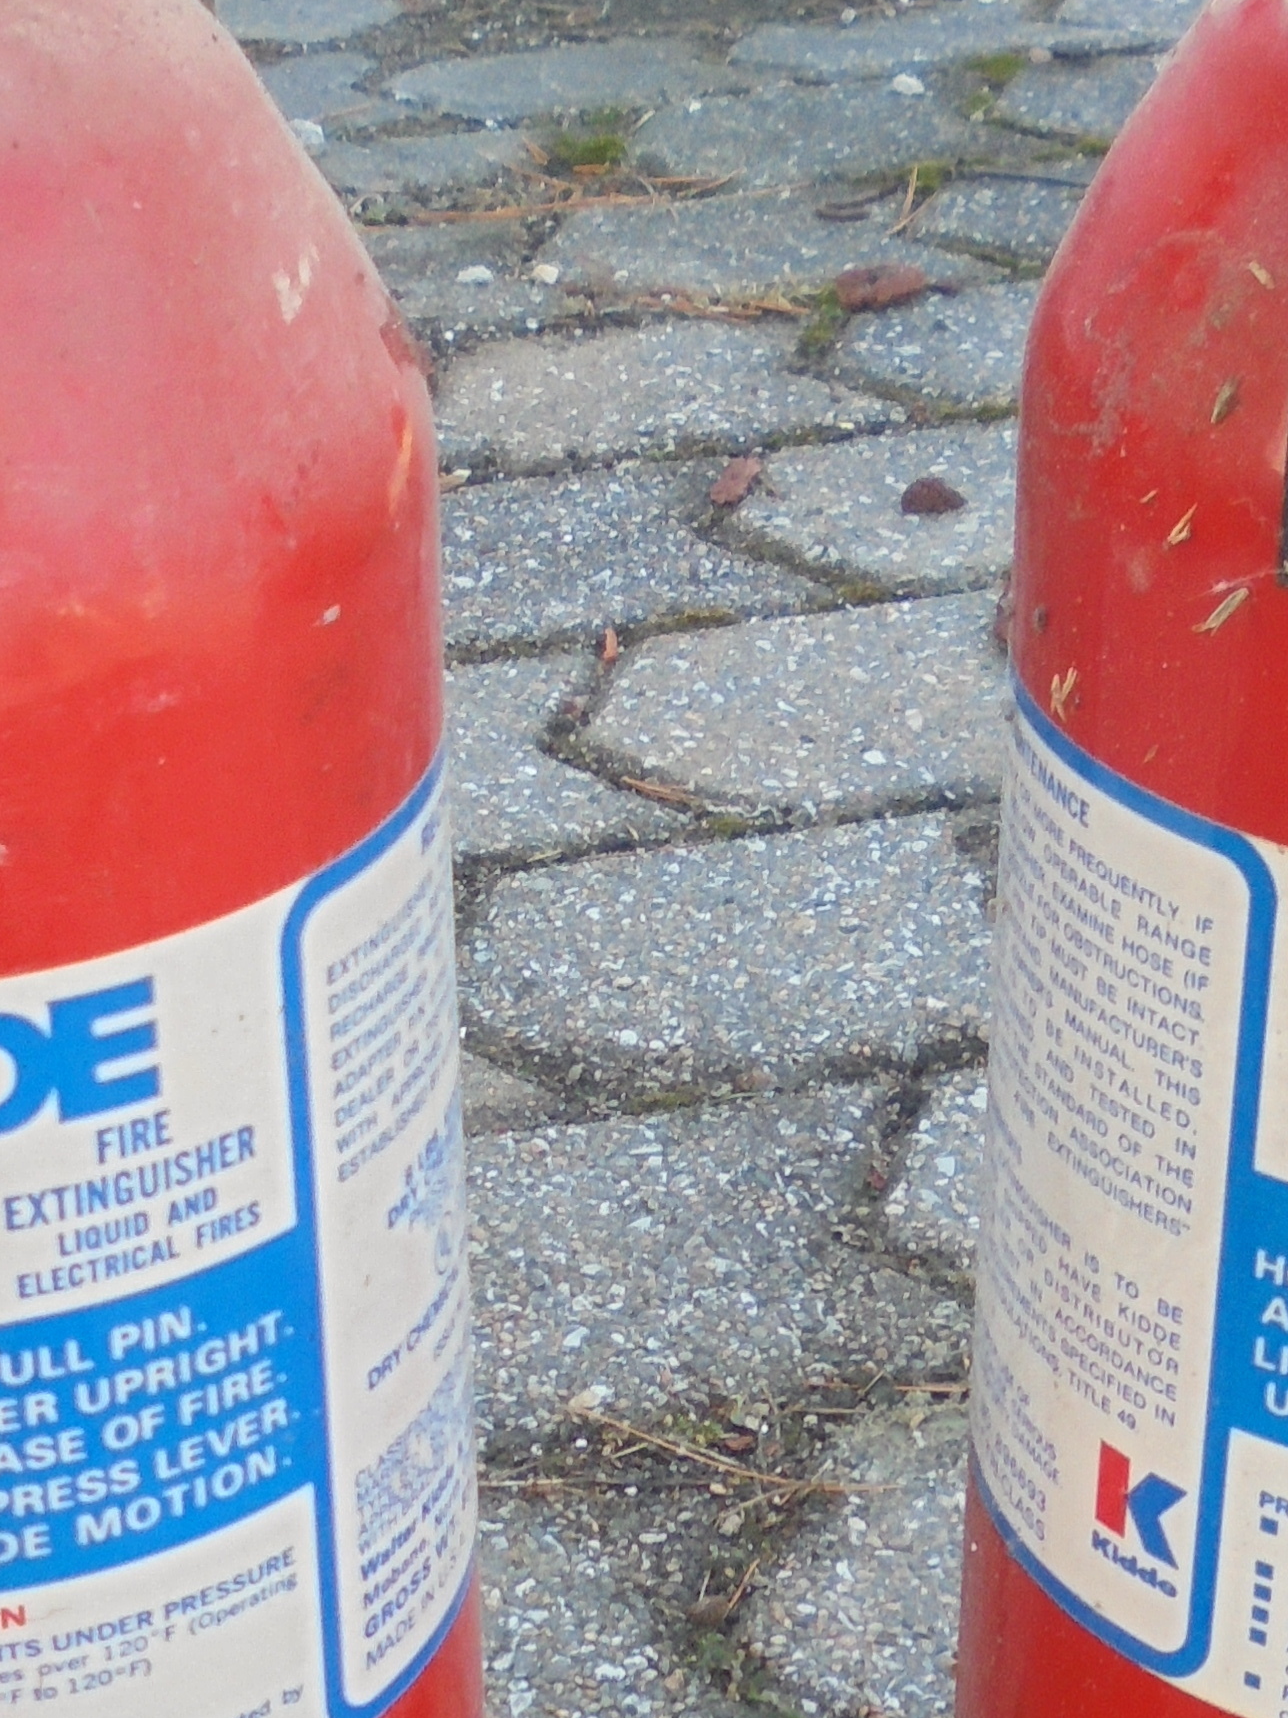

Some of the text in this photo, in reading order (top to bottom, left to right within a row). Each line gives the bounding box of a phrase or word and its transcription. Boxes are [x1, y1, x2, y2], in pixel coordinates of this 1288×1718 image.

[1069, 838, 1214, 934] FREQUENTLY IF
[1122, 936, 1209, 991] HOSE (IF
[1137, 913, 1212, 967] RANGE
[1155, 1068, 1202, 1106] THIS
[96, 1111, 173, 1163] FIRE
[4, 1125, 257, 1232] EXTINGUISHER
[17, 1201, 262, 1300] ELECTRICAL FIRES
[57, 1186, 219, 1257] LIQUID AND
[112, 1306, 207, 1360] PIN.
[1114, 1271, 1184, 1326] TO BE
[1118, 1302, 1182, 1351] KIDDE
[77, 1311, 294, 1414] UPRIGHT.
[103, 1407, 166, 1452] OF
[178, 1360, 287, 1427] FIRE.
[155, 1398, 300, 1484] LEVER.
[76, 1444, 293, 1548] MOTION.
[52, 1610, 153, 1651] UNDER
[164, 1546, 296, 1621] PRESSURE
